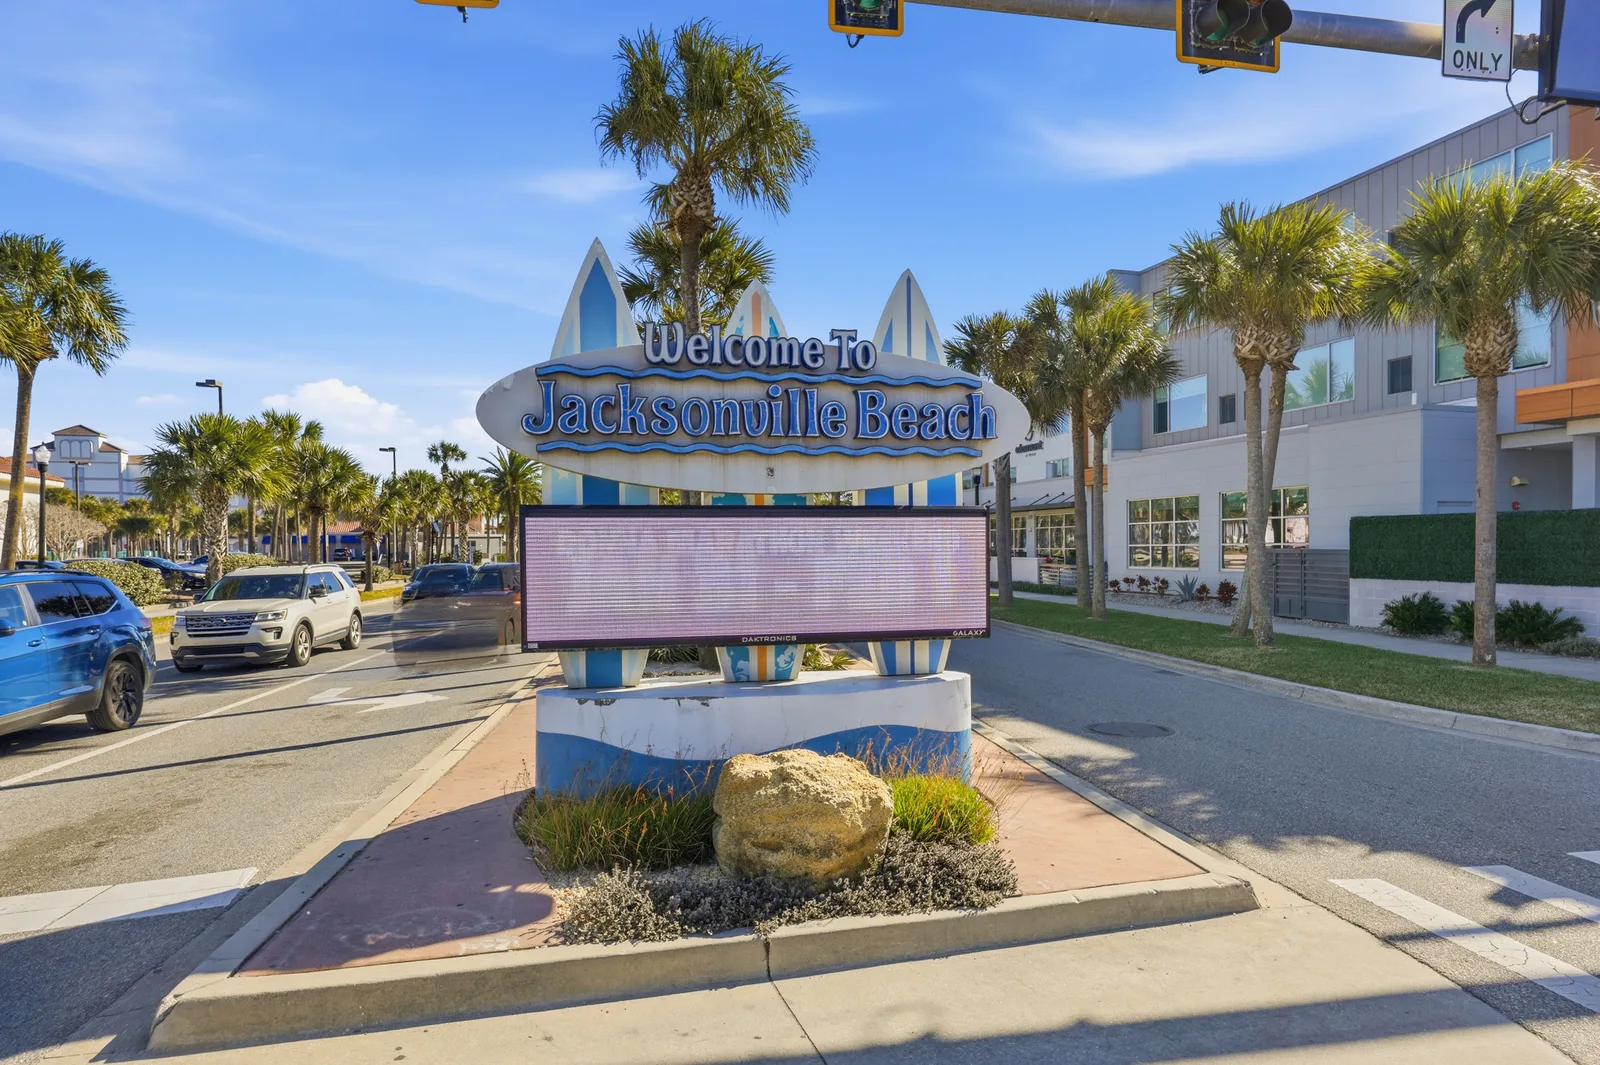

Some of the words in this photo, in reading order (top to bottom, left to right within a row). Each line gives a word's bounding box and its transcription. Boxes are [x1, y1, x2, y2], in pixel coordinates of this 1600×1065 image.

[1453, 49, 1503, 72] ONLY
[644, 321, 825, 370] Welcome
[830, 329, 877, 371] To
[521, 379, 848, 438] Jacksonville
[853, 388, 998, 440] Beach
[741, 635, 797, 643] DAKTRONICS
